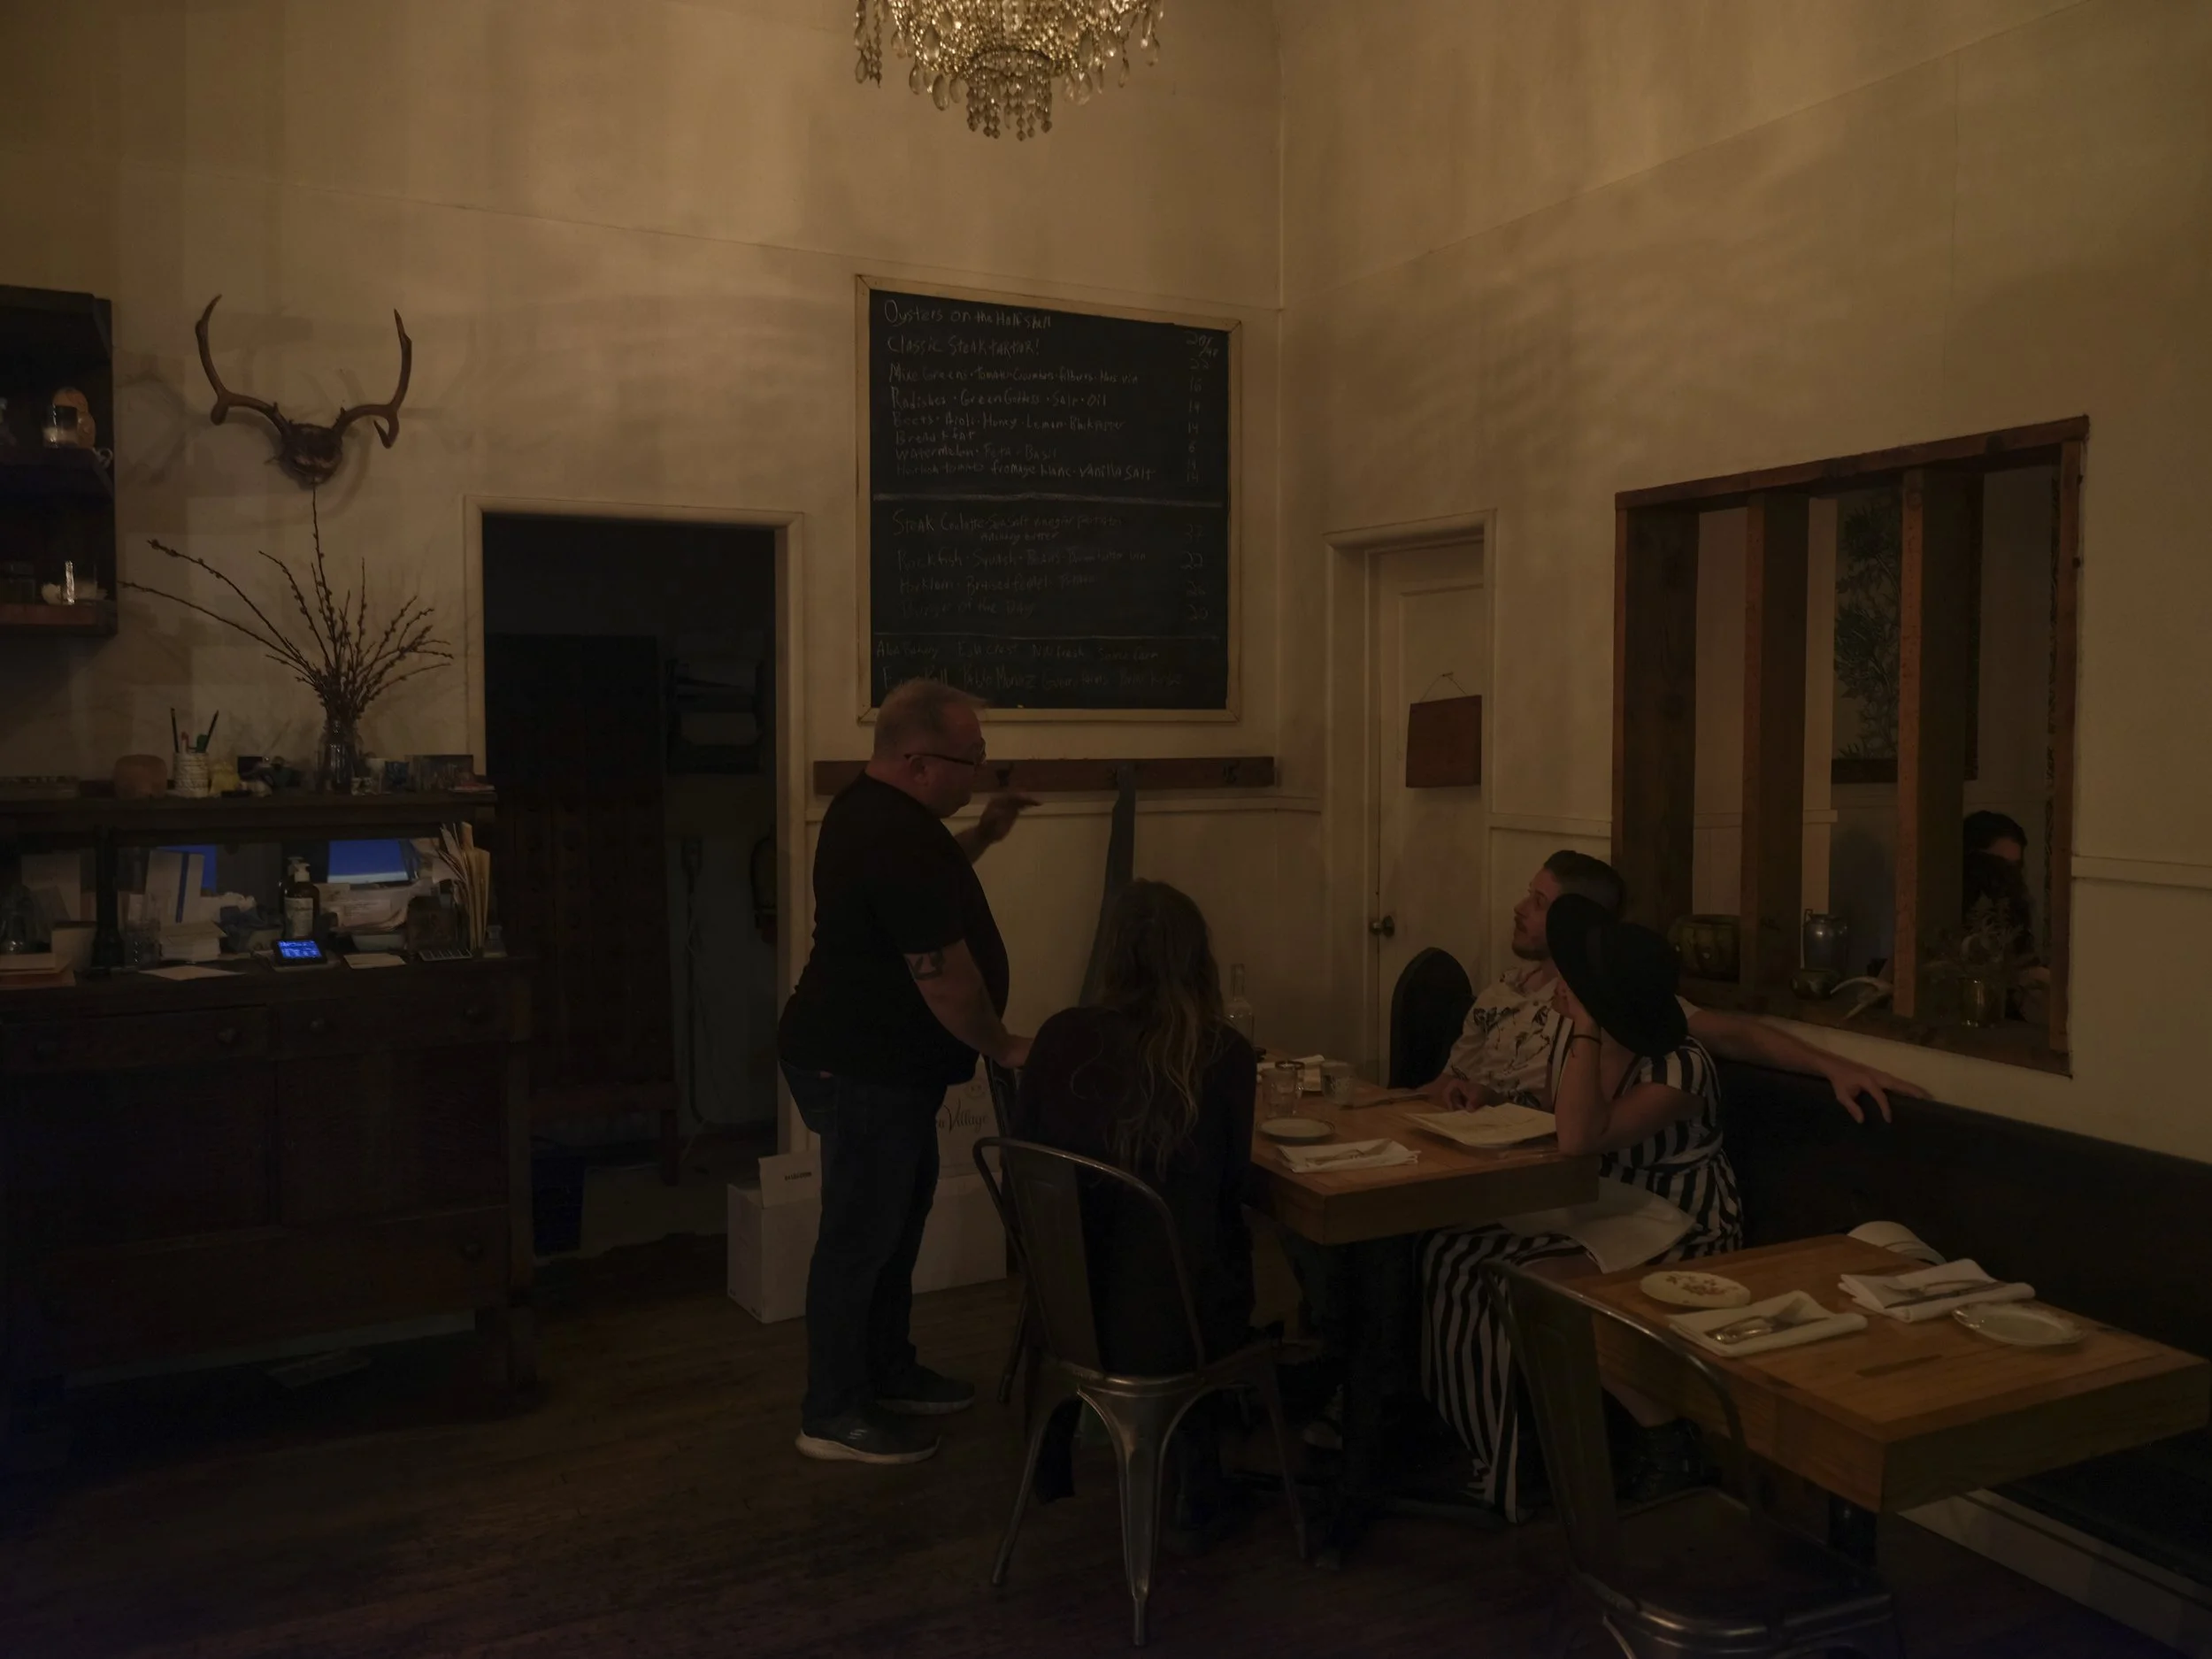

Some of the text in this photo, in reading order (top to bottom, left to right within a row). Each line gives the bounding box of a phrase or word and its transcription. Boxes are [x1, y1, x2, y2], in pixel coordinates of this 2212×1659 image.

[884, 299, 944, 327] Oysters
[949, 310, 972, 324] on
[975, 311, 992, 325] the
[887, 334, 943, 357] Classic
[1189, 374, 1202, 393] 16
[890, 385, 946, 411] Radishes
[982, 410, 1018, 431] Honey
[892, 509, 934, 536] Steak
